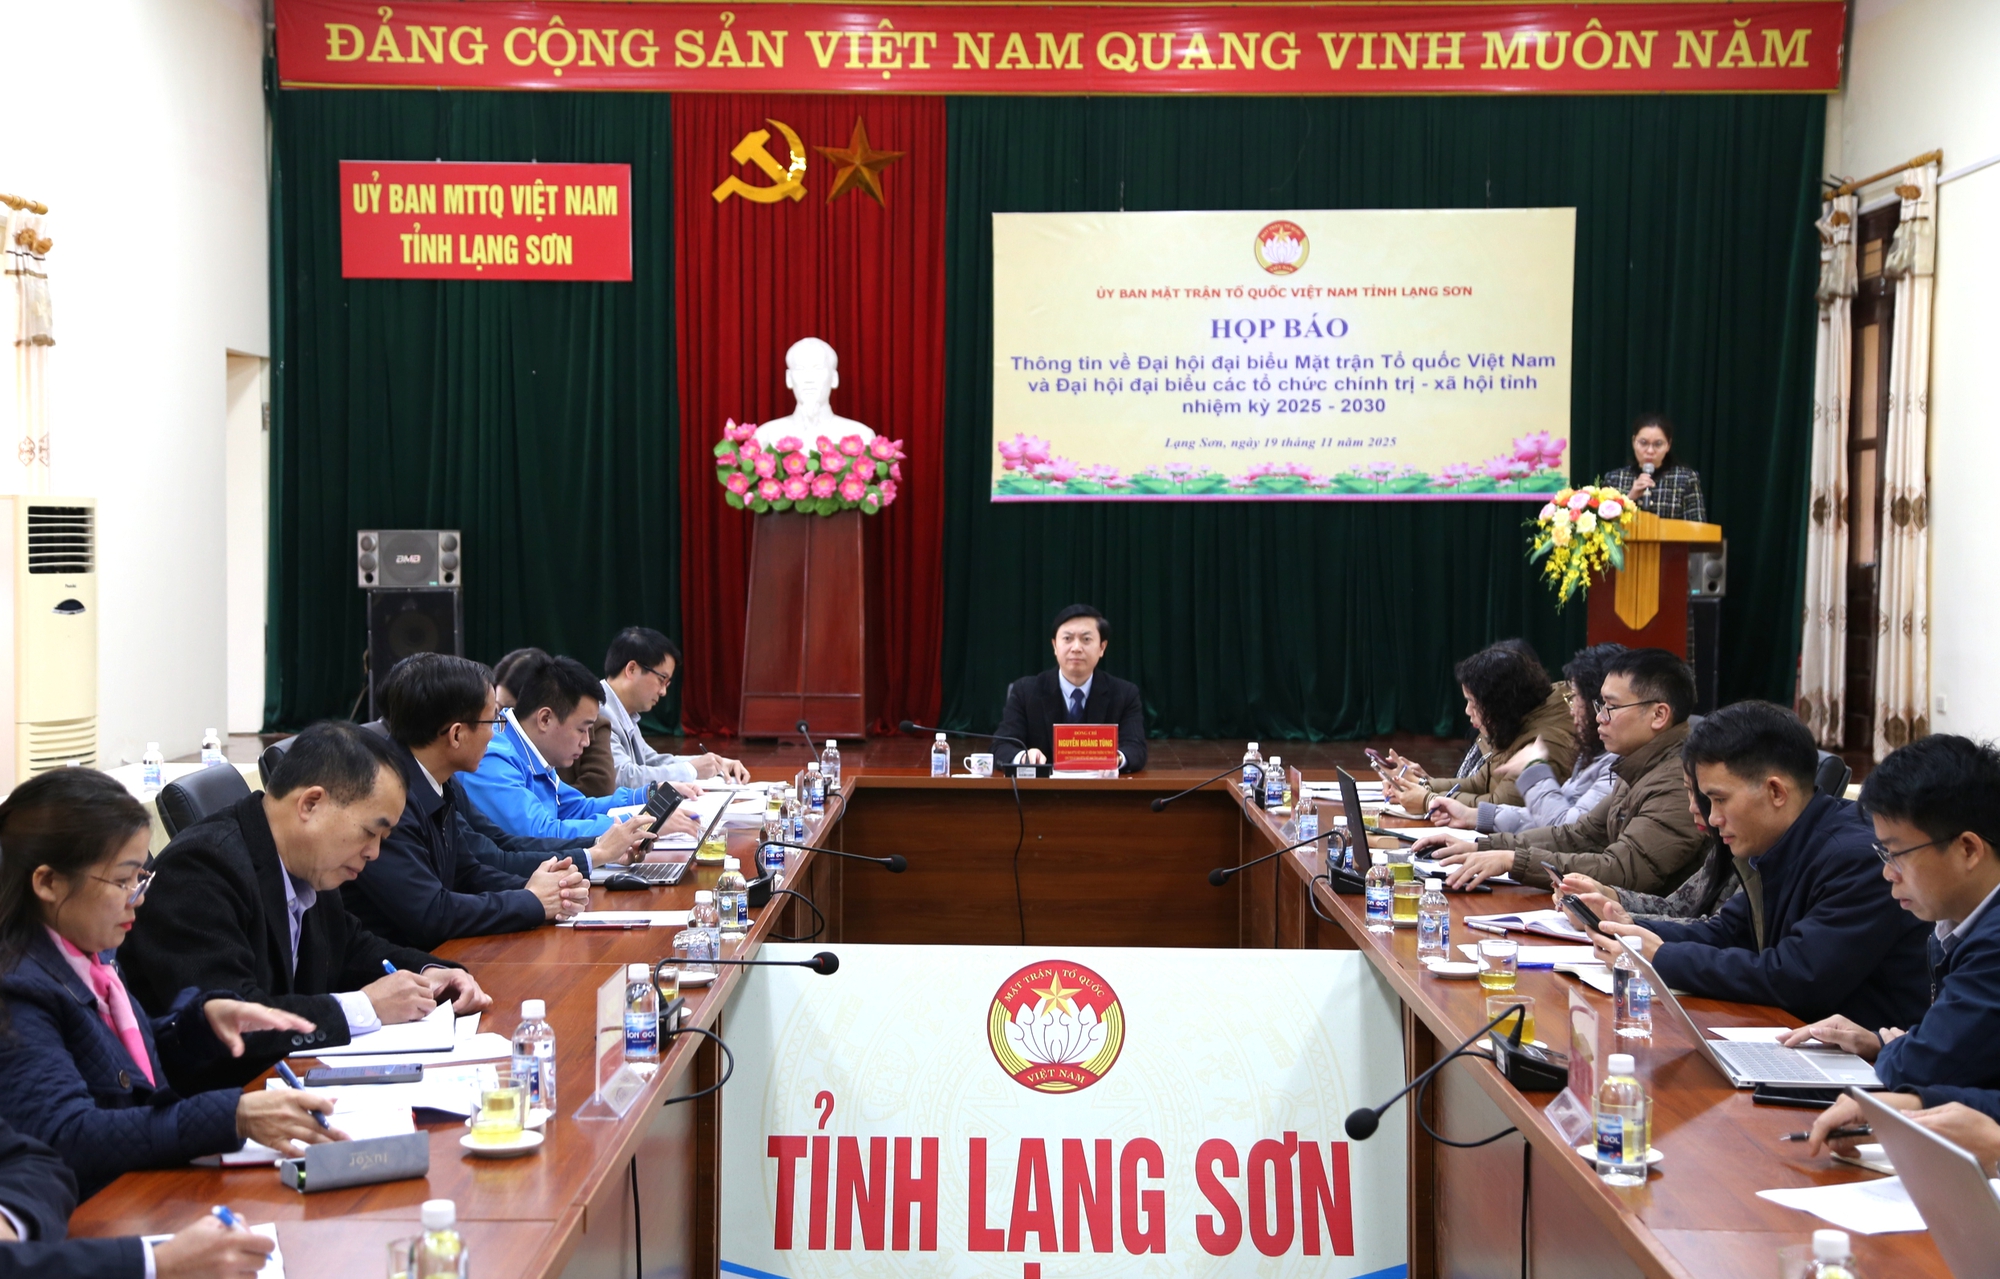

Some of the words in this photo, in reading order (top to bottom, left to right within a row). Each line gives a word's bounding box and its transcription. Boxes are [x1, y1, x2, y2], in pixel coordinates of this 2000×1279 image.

[324, 6, 489, 66] ĐẢNG
[504, 16, 660, 77] CỘNG
[675, 12, 789, 69] SẢN
[805, 19, 937, 80] VIỆT
[953, 32, 1084, 70] NAM
[1096, 31, 1302, 73] QUANG
[1317, 31, 1466, 70] VINH
[1480, 18, 1659, 71] MUÔN
[1673, 20, 1811, 69] NĂM
[353, 171, 382, 214] UỶ
[389, 184, 437, 214] BAN
[443, 185, 504, 218] MTTQ
[510, 179, 559, 222] VIỆT
[565, 186, 618, 216] NAM
[400, 222, 453, 264] TỈNH
[459, 234, 519, 271] LẠNG
[526, 233, 573, 265] SƠN
[1096, 286, 1114, 299] ỦY
[1119, 289, 1147, 299] BAN
[1151, 287, 1180, 301] MẶT
[1186, 286, 1222, 301] TRẬN
[1247, 285, 1287, 300] QUỐC
[1291, 284, 1323, 300] VIỆT
[1327, 288, 1358, 298] NAM
[1362, 284, 1397, 297] TỈNH
[1401, 287, 1438, 299] LẠNG
[1443, 286, 1473, 297] SƠN
[1211, 318, 1276, 344] HỌP
[1284, 313, 1349, 338] BÁO
[1011, 356, 1072, 374] Thông
[1078, 356, 1103, 370] tin
[1109, 352, 1131, 370] về
[1137, 355, 1169, 374] Đại
[1175, 356, 1205, 373] hội
[1211, 355, 1241, 373] đại
[1247, 352, 1288, 370] biểu
[1295, 354, 1330, 372] Mặt
[1336, 354, 1375, 372] trận
[1381, 351, 1406, 369] Tổ
[1412, 350, 1461, 371] quốc
[1468, 353, 1505, 371] Việt
[1512, 353, 1556, 368] Nam
[1028, 377, 1050, 392] và
[1056, 378, 1087, 395] Đại
[1094, 378, 1123, 395] hội
[1130, 377, 1159, 394] đại
[1165, 374, 1206, 392] biểu
[1213, 377, 1246, 392] các
[1253, 373, 1272, 392] tổ
[1278, 377, 1327, 391] chức
[1334, 376, 1388, 391] chính
[1395, 376, 1415, 394] trị
[1434, 376, 1456, 390] xã
[1463, 375, 1494, 393] hội
[1500, 374, 1538, 390] tỉnh
[1182, 398, 1241, 417] nhiệm
[1248, 398, 1270, 416] kỳ
[1277, 398, 1322, 414] 2025
[1341, 398, 1386, 413] 2030
[1165, 437, 1196, 450] Lạng
[1199, 437, 1227, 450] Sơn,
[1231, 437, 1260, 450] ngày
[1264, 437, 1279, 448] 19
[1281, 437, 1316, 450] tháng
[1320, 437, 1333, 448] 11
[1336, 437, 1364, 448] năm
[1367, 437, 1398, 447] 2025
[396, 554, 421, 564] BMB
[1004, 981, 1024, 1003] MẶT
[1023, 968, 1053, 985] TRẬN
[1062, 968, 1077, 979] TỔ
[1078, 974, 1105, 998] QUỐC
[1027, 1068, 1056, 1083] VIỆT
[1059, 1069, 1086, 1084] NAM
[767, 1090, 939, 1252] TỈNH
[968, 1136, 1167, 1279] LẠNG
[1195, 1130, 1355, 1257] SƠN
